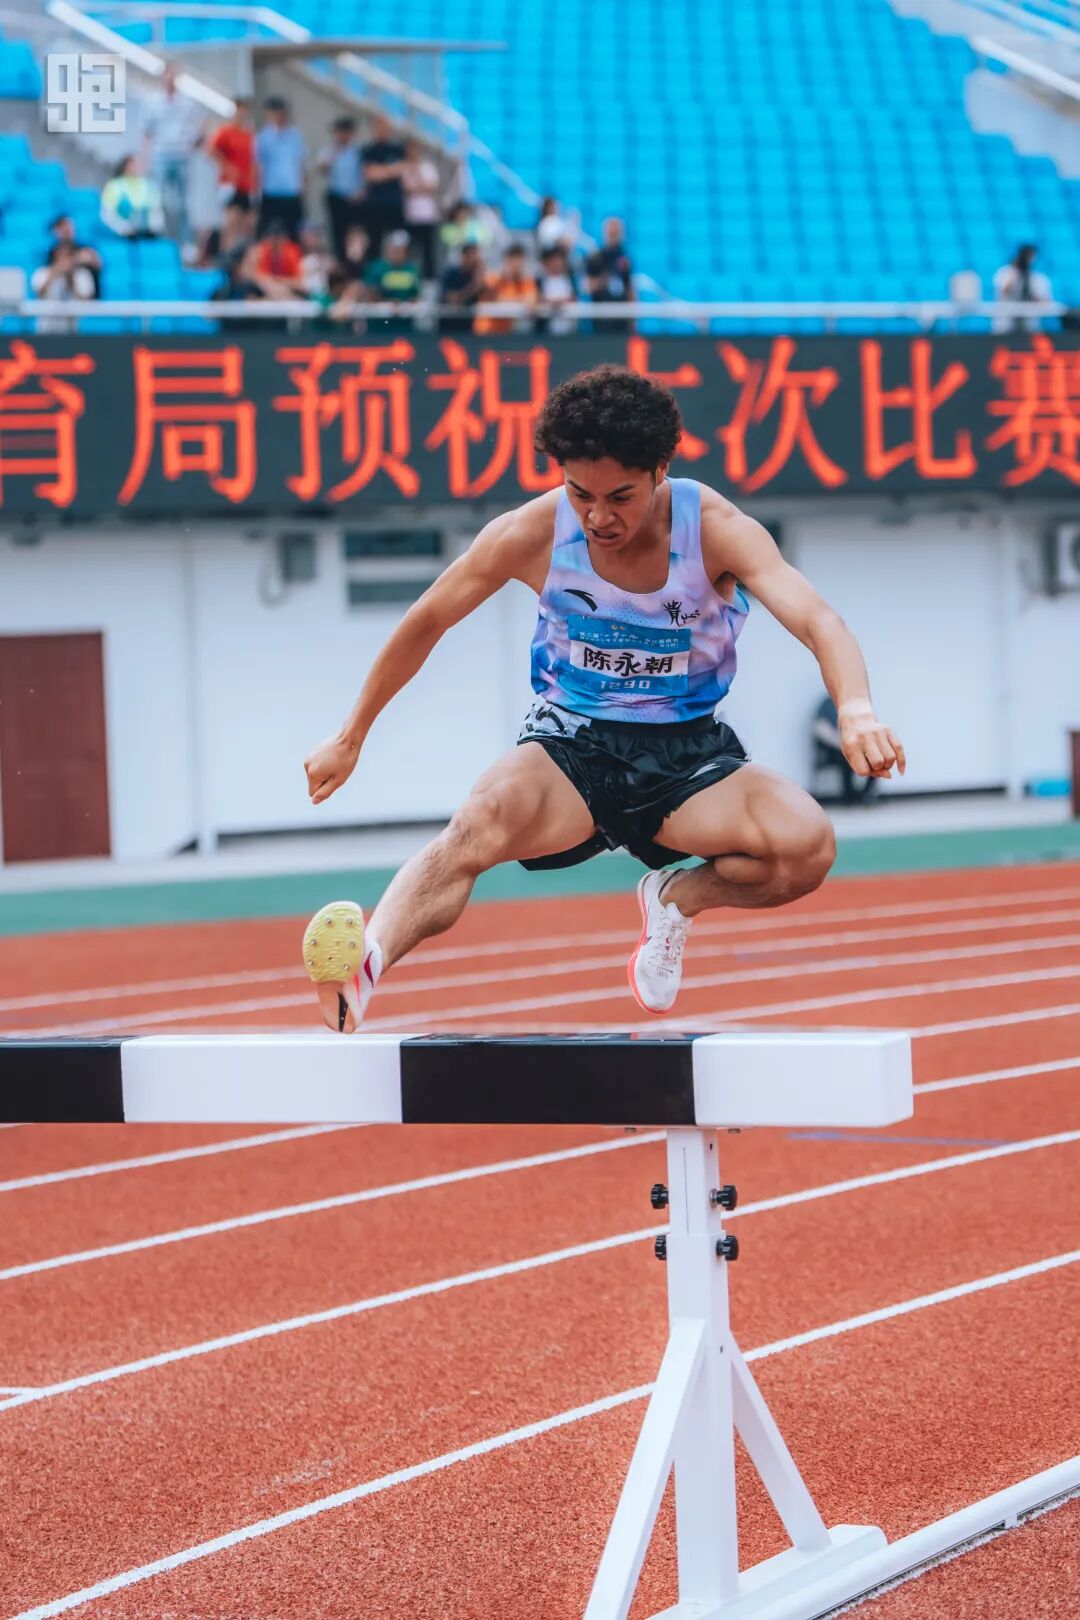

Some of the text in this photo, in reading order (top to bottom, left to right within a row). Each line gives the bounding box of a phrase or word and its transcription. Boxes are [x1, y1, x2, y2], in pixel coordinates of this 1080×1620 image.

[583, 646, 674, 677] 陈永朝
[600, 680, 651, 690] 1290
